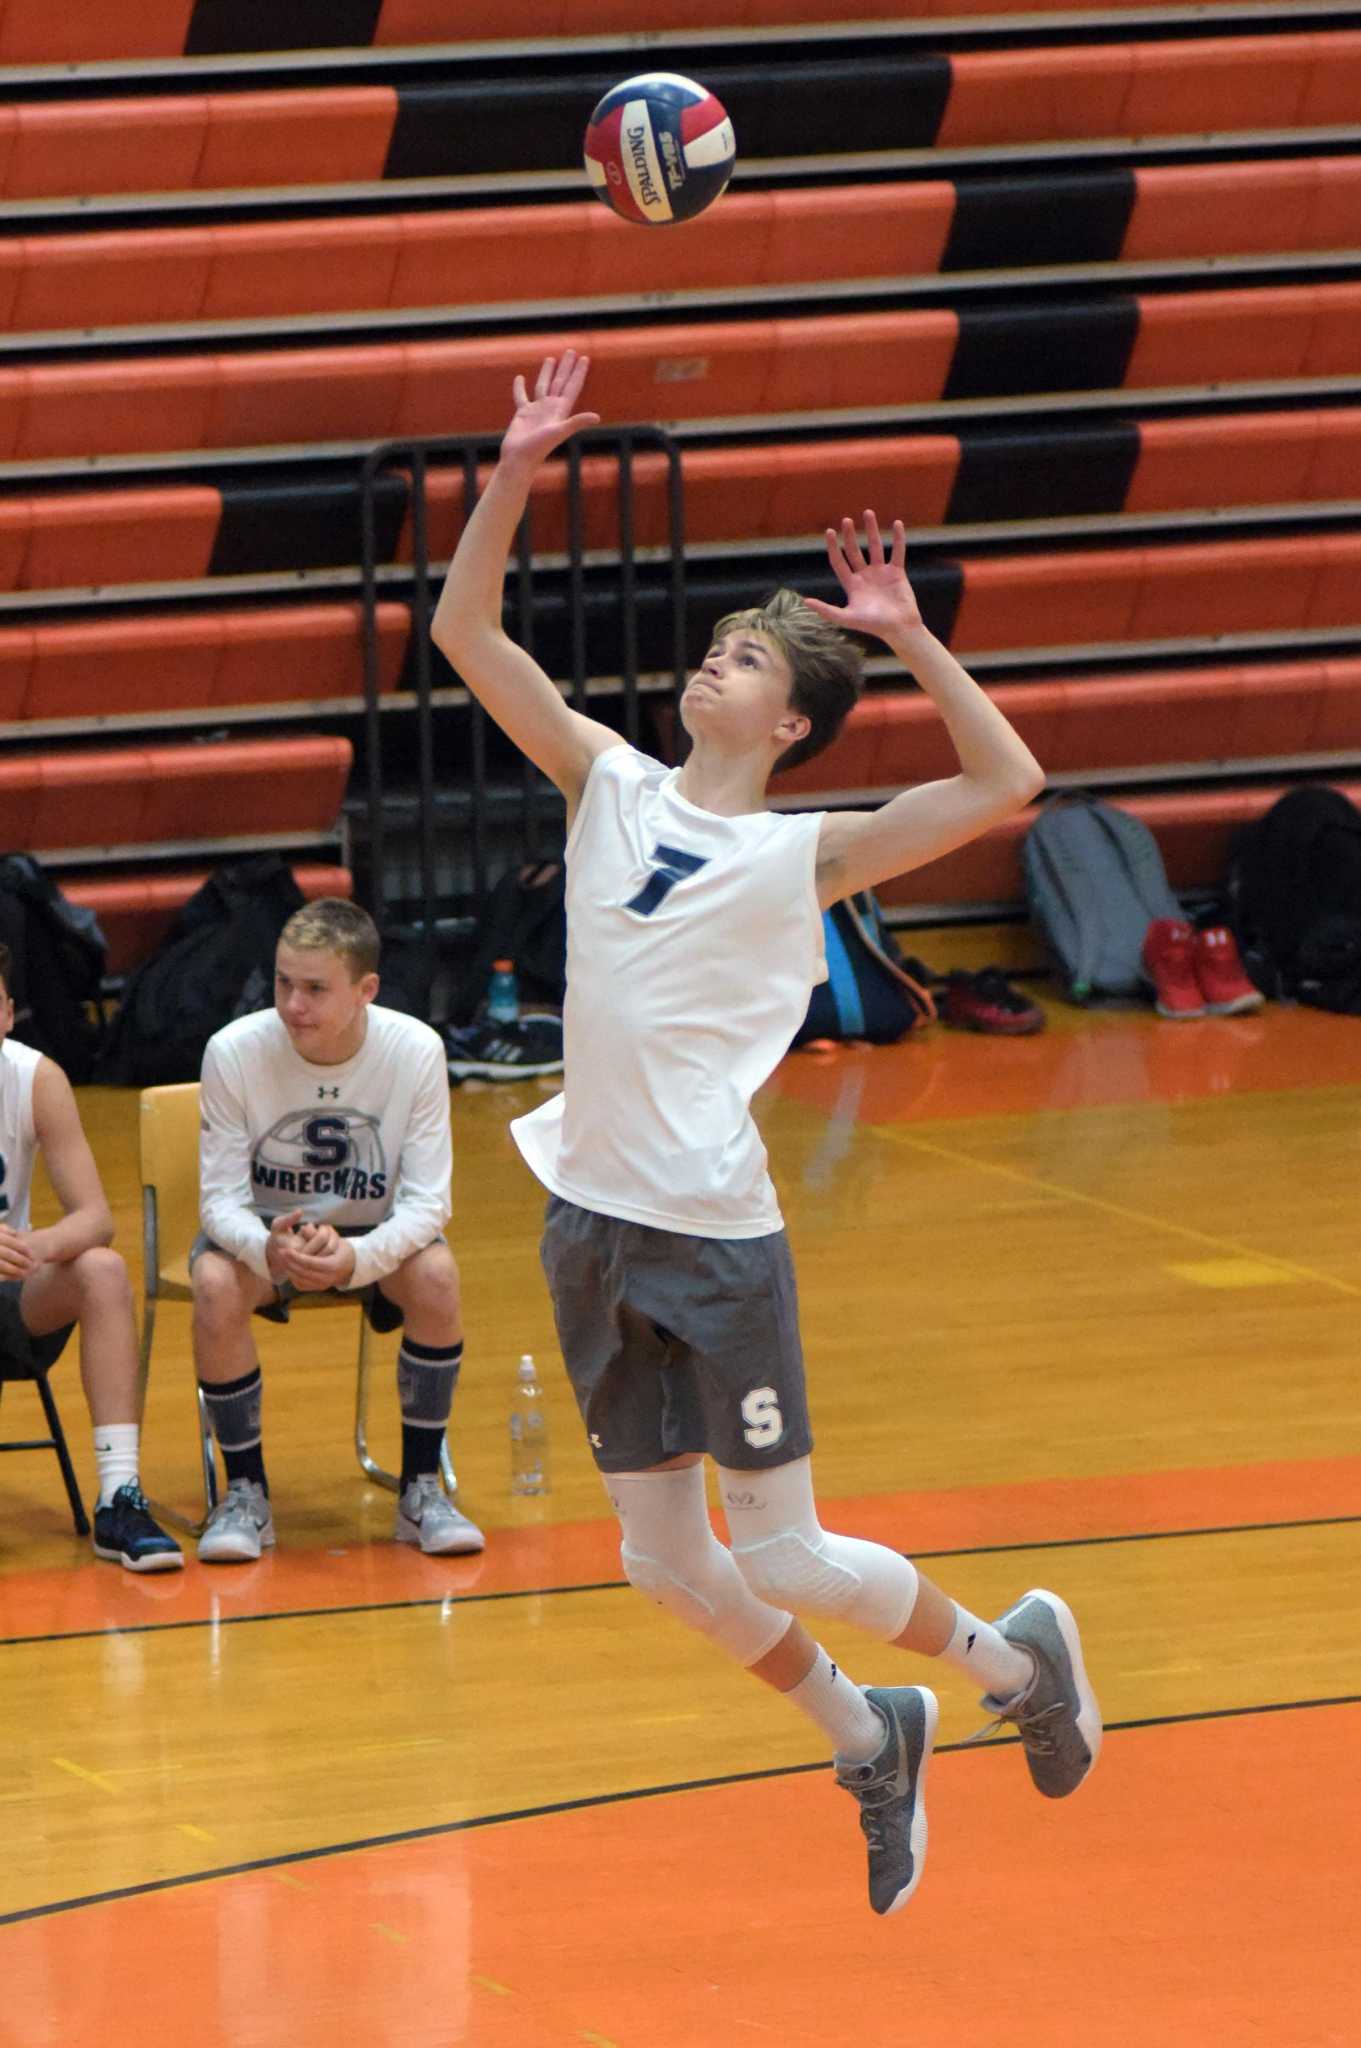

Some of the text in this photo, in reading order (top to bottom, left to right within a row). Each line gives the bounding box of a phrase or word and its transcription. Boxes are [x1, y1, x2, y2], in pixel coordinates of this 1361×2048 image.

[626, 126, 661, 206] SPALDING
[622, 842, 712, 918] 7
[302, 1114, 349, 1167] S
[252, 1160, 387, 1201] WRECKRS
[741, 1386, 784, 1448] S
